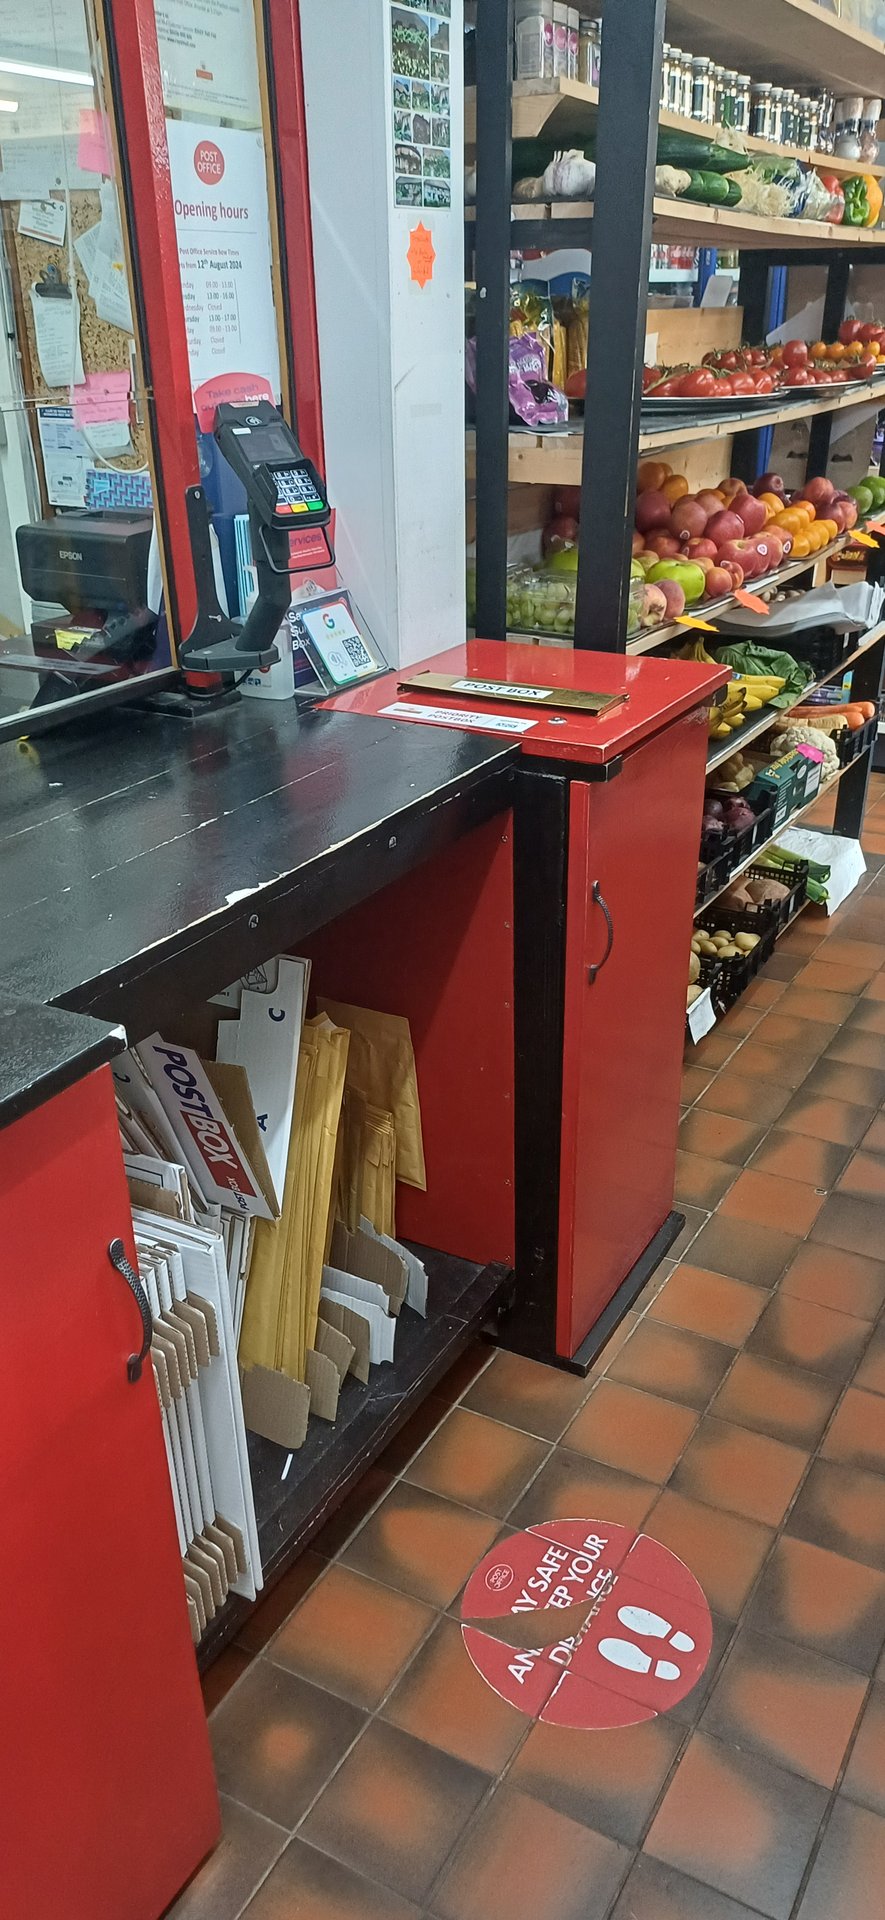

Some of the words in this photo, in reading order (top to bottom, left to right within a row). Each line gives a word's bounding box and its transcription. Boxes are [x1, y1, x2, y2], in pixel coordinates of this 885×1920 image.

[200, 151, 218, 161] POST
[197, 162, 221, 174] OFFICE
[175, 200, 218, 221] Opening
[220, 202, 248, 219] hours
[210, 260, 228, 271] August
[229, 260, 242, 269] 2024
[207, 389, 231, 399] Take
[245, 393, 269, 401] here
[290, 533, 322, 547] ervices
[59, 551, 82, 560] EPSON
[292, 638, 310, 651] Box
[464, 682, 502, 693] POST
[508, 687, 543, 696] BOX
[435, 710, 482, 720] PRIORITY
[152, 1045, 237, 1169] POSTBOX
[490, 1568, 502, 1583] POST
[528, 1546, 569, 1592] SAFE
[508, 1648, 543, 1684] AN
[545, 1585, 573, 1609] EP
[562, 1534, 608, 1584] YOUR
